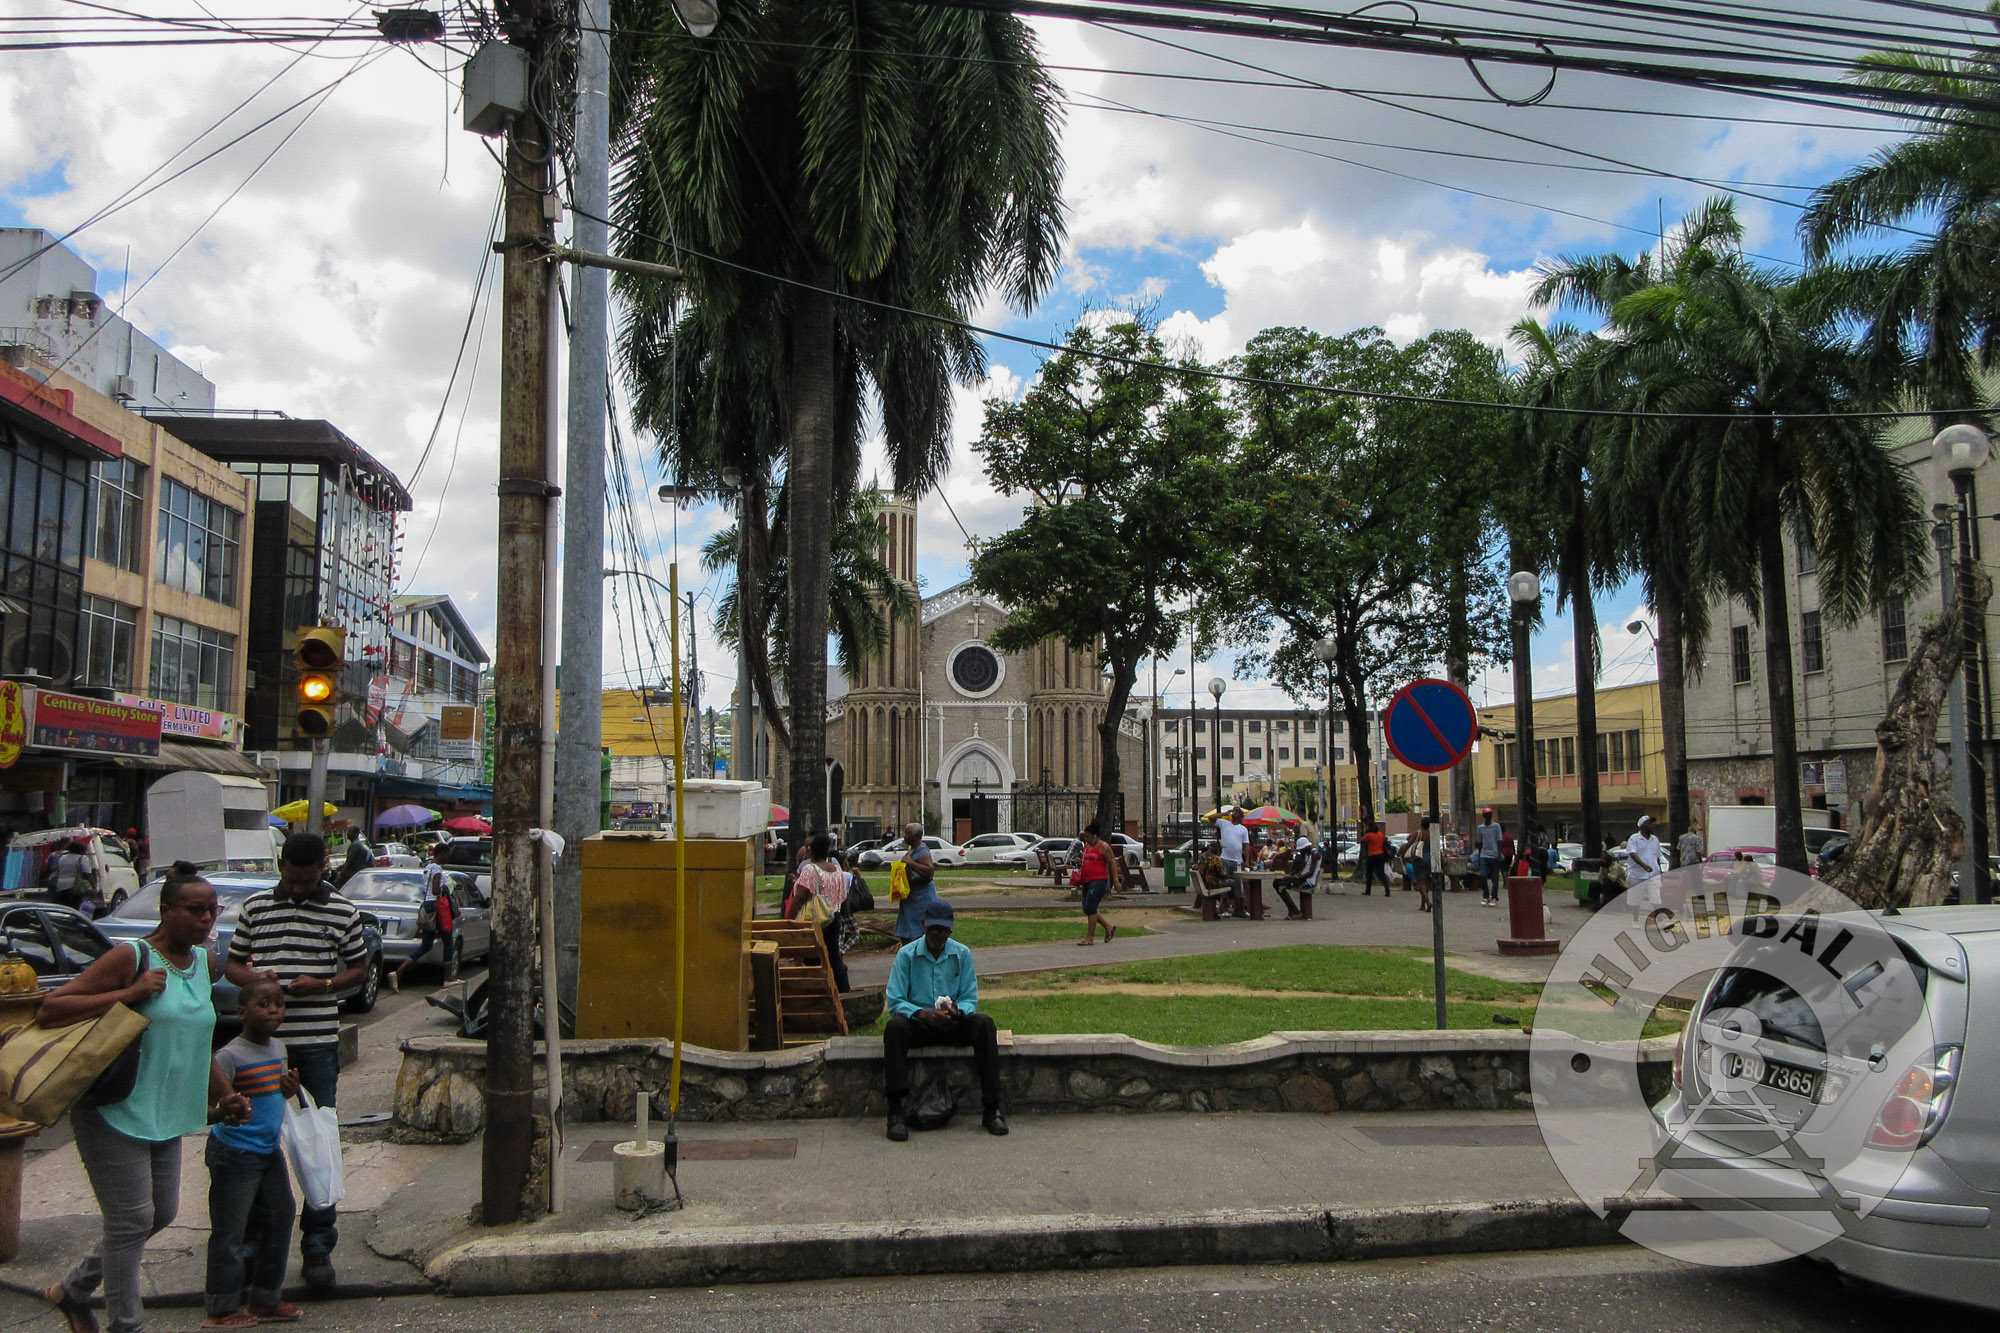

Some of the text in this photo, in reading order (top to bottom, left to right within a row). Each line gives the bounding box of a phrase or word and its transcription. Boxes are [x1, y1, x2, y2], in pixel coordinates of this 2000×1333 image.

[42, 694, 85, 712] Centre
[87, 701, 128, 721] Variety
[130, 709, 158, 723] Store
[175, 706, 211, 725] UNITED
[162, 720, 200, 734] ERMARKET
[1732, 1053, 1812, 1094] PBU 7365
